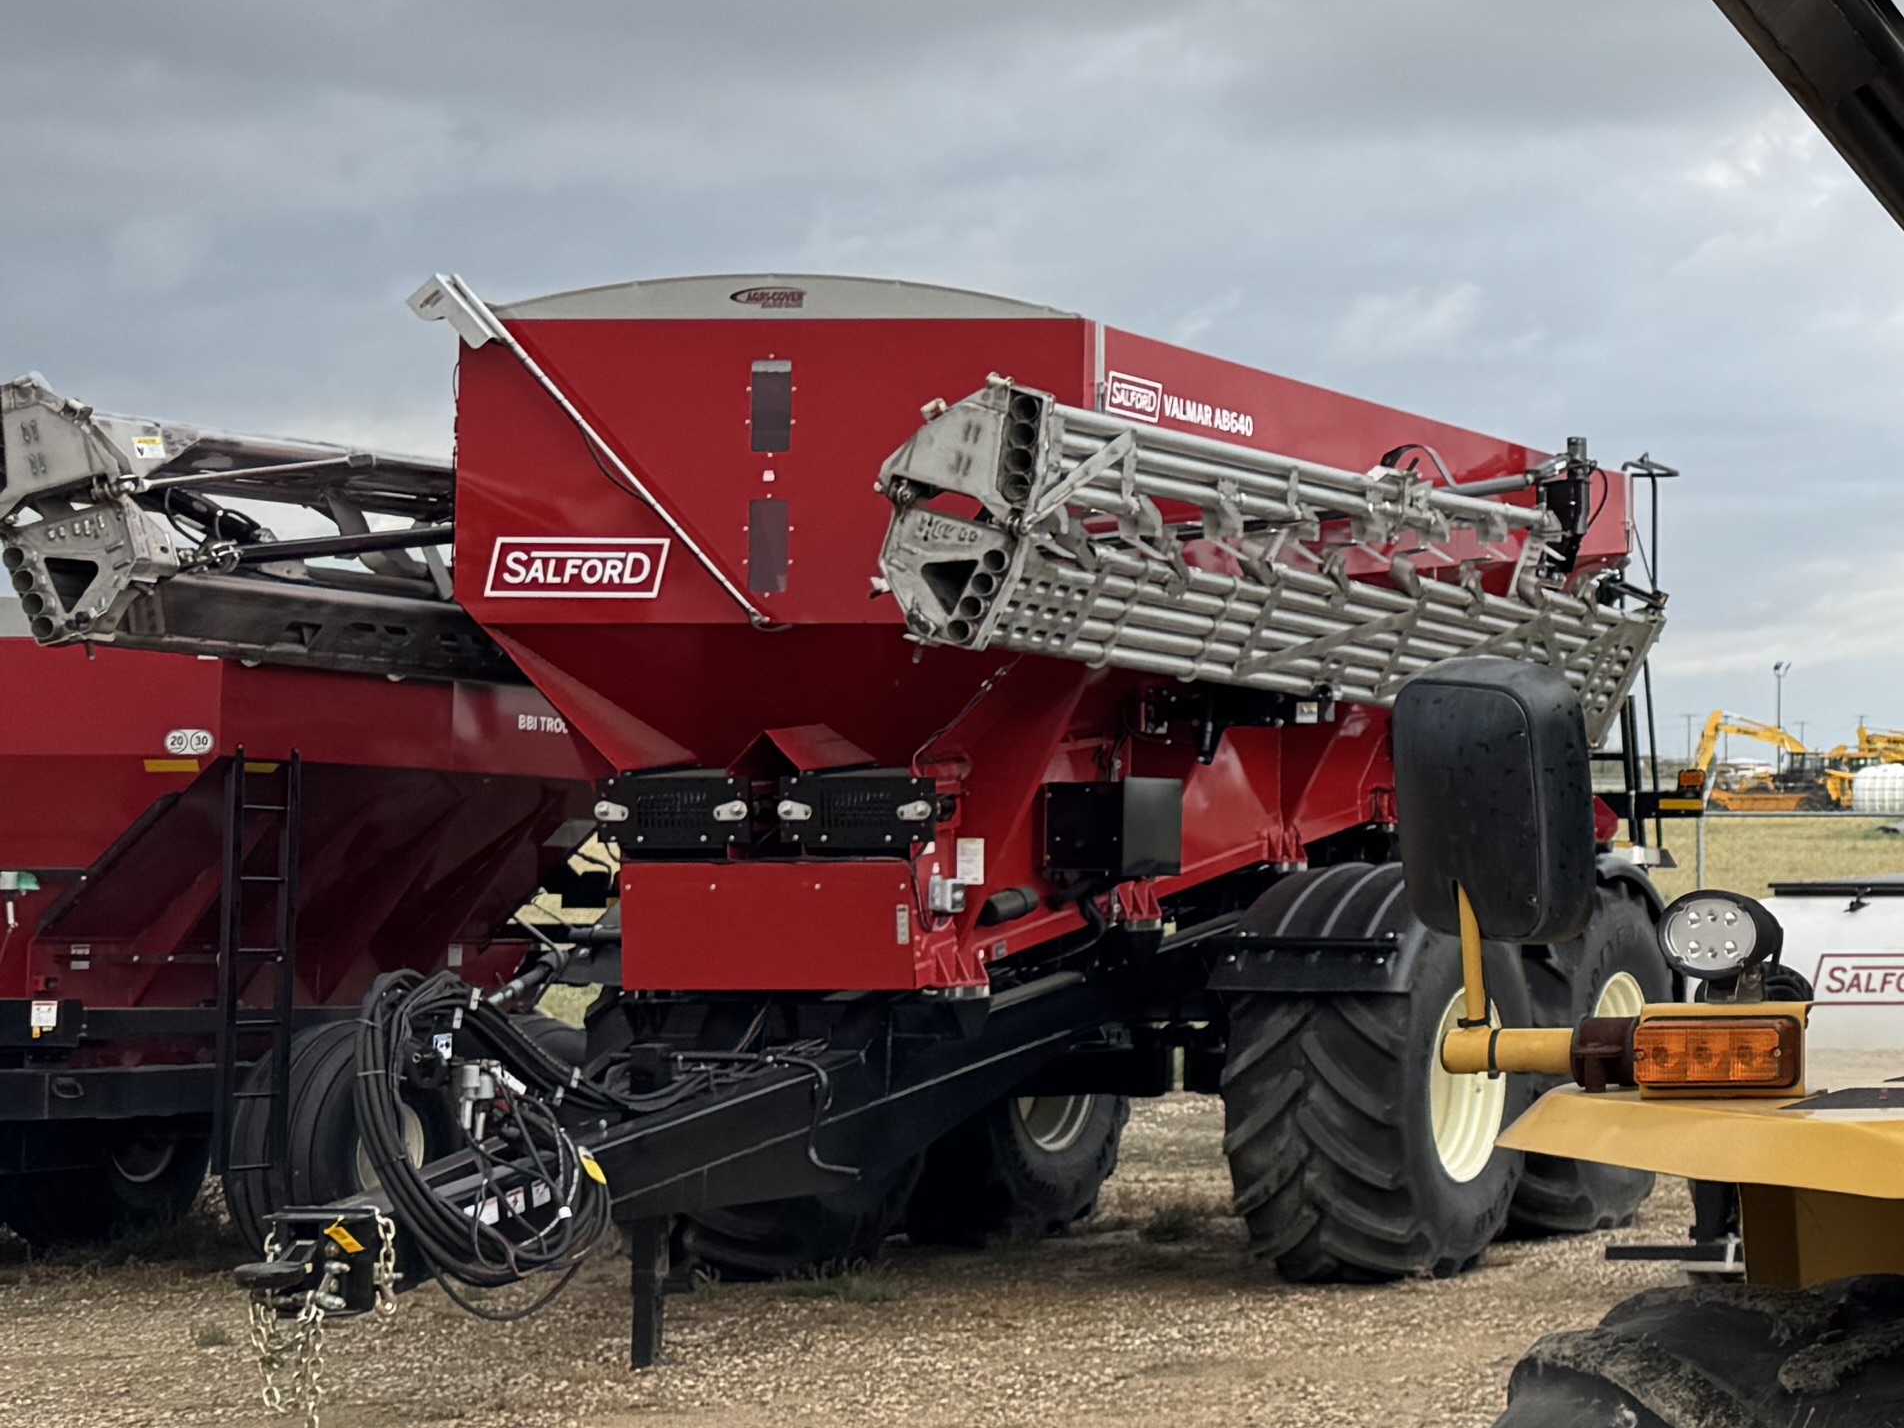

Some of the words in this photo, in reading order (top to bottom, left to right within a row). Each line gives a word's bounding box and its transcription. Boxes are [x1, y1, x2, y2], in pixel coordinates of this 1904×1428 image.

[1111, 381, 1157, 413] SALFORD
[1163, 393, 1213, 428] VALMAR
[1214, 408, 1254, 437] AB640
[502, 551, 651, 584] SALFORD
[518, 714, 538, 730] BBI
